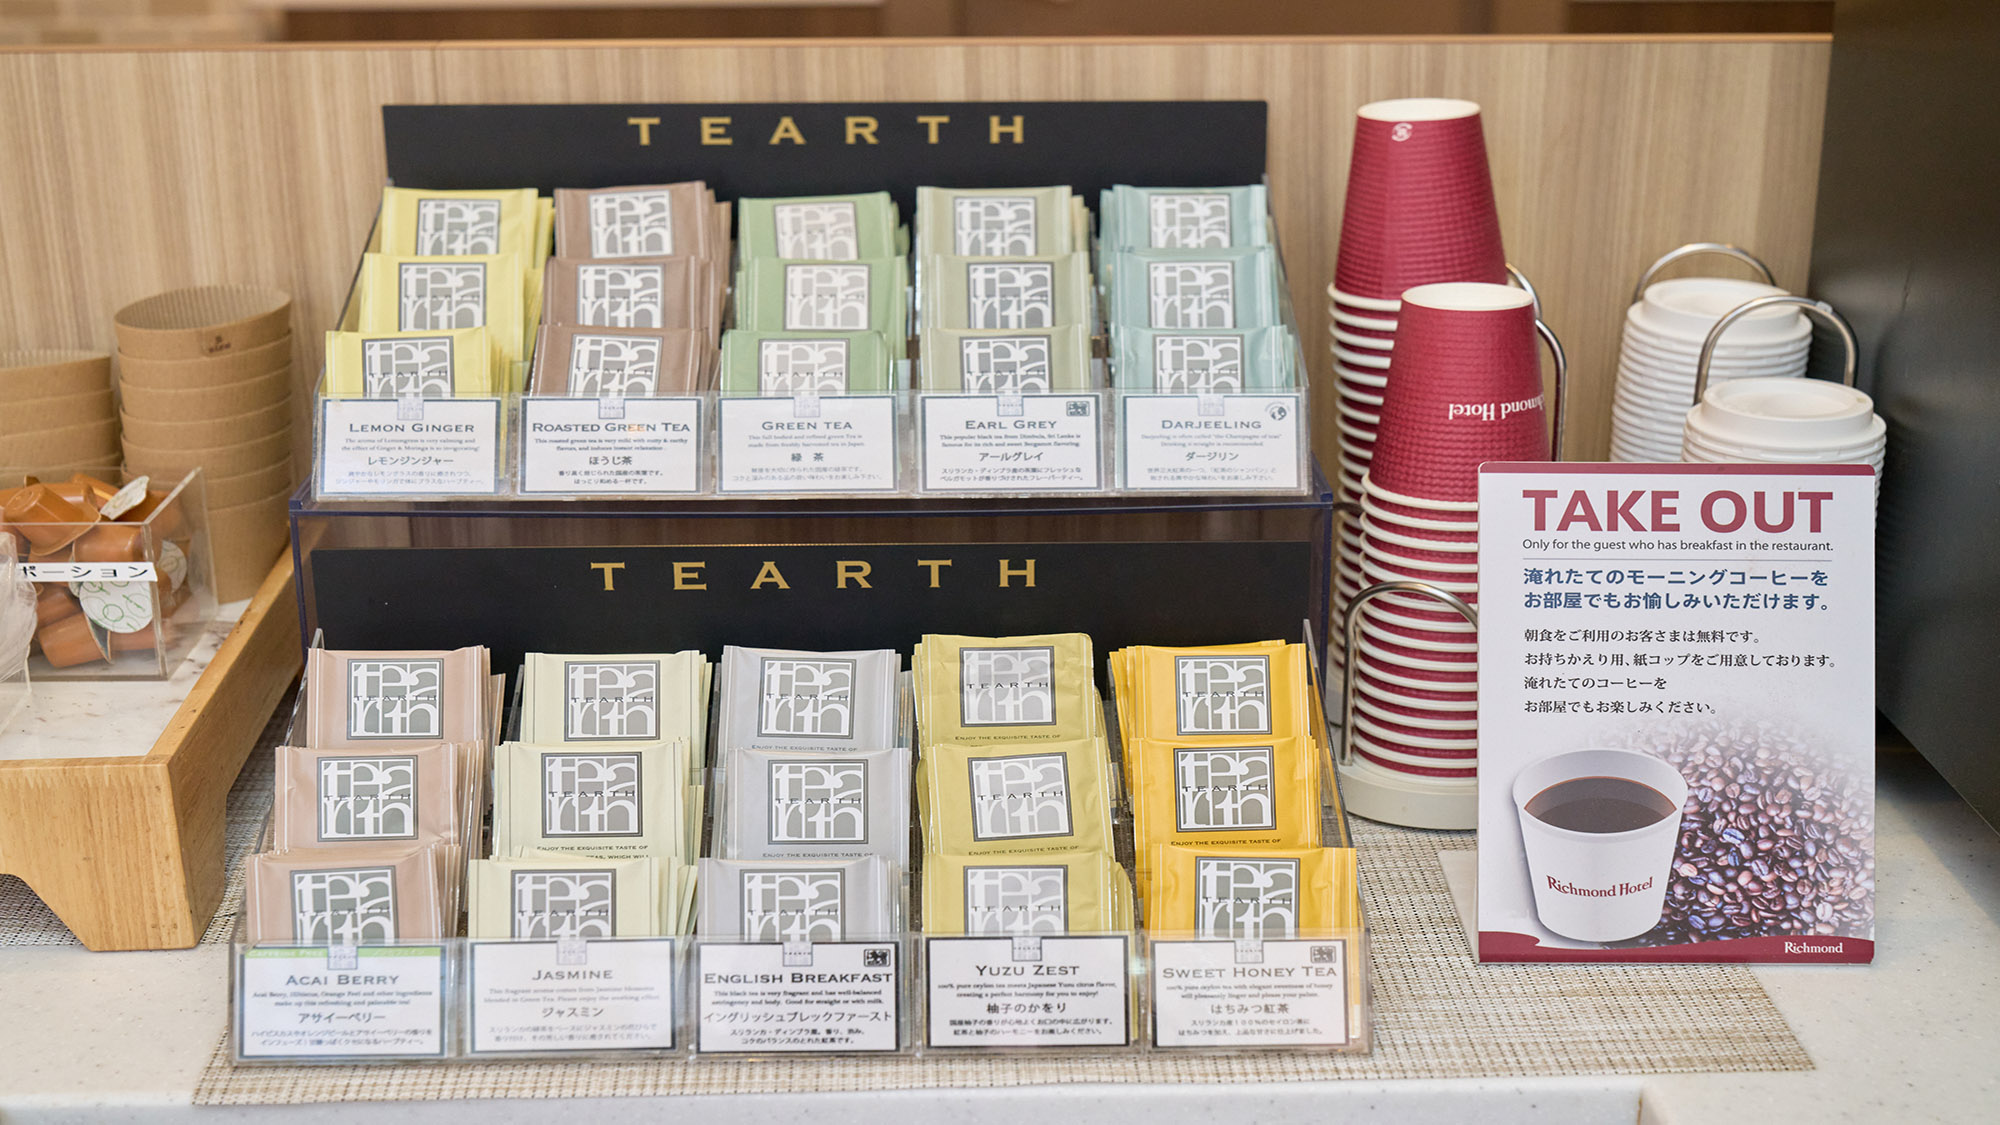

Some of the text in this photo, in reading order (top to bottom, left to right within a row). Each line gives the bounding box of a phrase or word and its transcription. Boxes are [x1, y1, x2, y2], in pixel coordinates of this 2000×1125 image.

[627, 115, 1025, 146] TEARTH
[1448, 403, 1495, 421] Hotel
[350, 423, 475, 433] LEMON GINGER
[532, 422, 690, 432] ROASTED GREEN TEA
[762, 421, 853, 430] GREEN TEA
[965, 420, 1057, 429] EARL GREY
[1161, 419, 1262, 429] DARJEELING
[368, 456, 454, 466] レモンジンジャー
[589, 456, 632, 466] ほうじ茶
[979, 451, 1044, 462] アールグレイ
[1185, 451, 1239, 462] ダージリン
[1522, 490, 1834, 533] TAKE OUT
[1522, 538, 1834, 552] Only for the guest who has breakfast in the restaurant.
[590, 558, 1037, 592] TEARTH
[1523, 568, 1828, 586] 淹れたてのモーニングコーヒーを
[1523, 591, 1829, 611] お部屋でもお愉しみいただけます。
[1523, 628, 1760, 644] 朝食をご利用のお客さまは無料です。
[1523, 652, 1836, 669] お持ちかえり用、紙コップをご用意しております。
[1523, 676, 1667, 690] 淹れたてのコーヒーを
[766, 693, 848, 701] TEARTH
[1523, 699, 1716, 715] お部屋でもお楽しみください。
[1182, 784, 1269, 792] TEARTH
[325, 793, 411, 801] TEARTH
[549, 790, 635, 798] TEARTH
[978, 790, 1064, 801] TEARTH
[775, 797, 861, 805] TEARTH
[1546, 874, 1653, 898] Richmond Hotel
[1202, 896, 1292, 905] TEARTH
[519, 909, 609, 917] TEARTH
[748, 908, 838, 916] TEARTH
[1784, 940, 1844, 954] Richmond
[532, 969, 613, 981] JASMINE
[976, 965, 1080, 976] YUZU ZEST
[1162, 966, 1337, 979] SWEET HONEY TEA
[286, 975, 400, 986] ACAI BERRY
[704, 973, 893, 984] ENGLISH BREAKFAST
[542, 1007, 604, 1018] ジャスミン
[987, 1002, 1067, 1014] 柚子のかをり
[1211, 1003, 1290, 1015] はちみつ紅茶
[299, 1012, 386, 1024] アサイーベリー
[704, 1011, 892, 1023] イングリッシュブレックファースト
